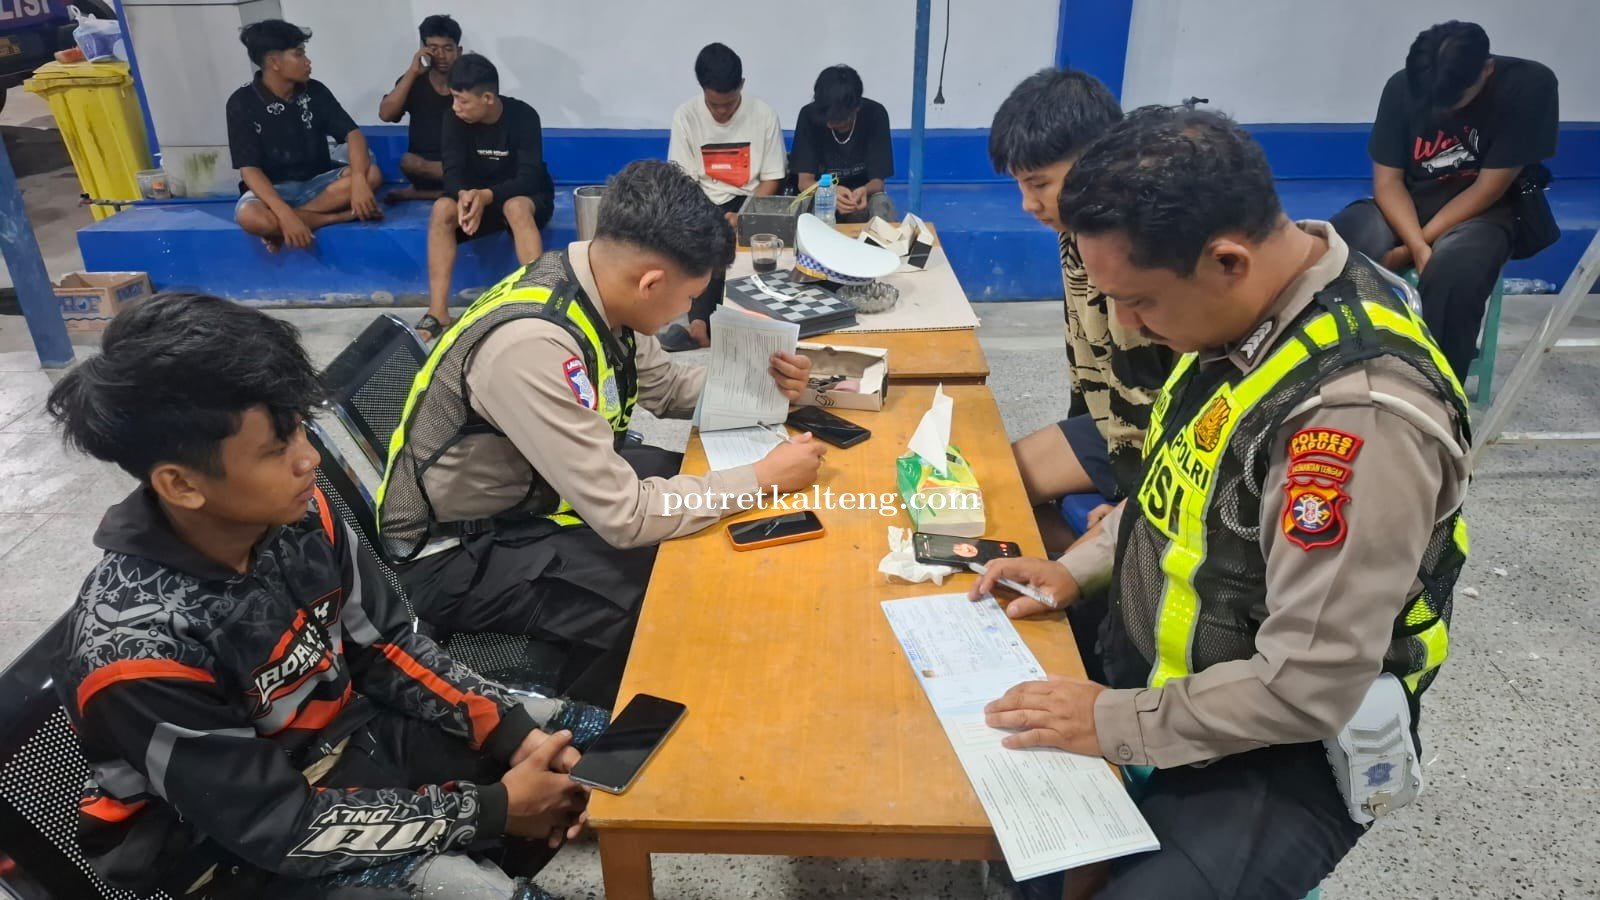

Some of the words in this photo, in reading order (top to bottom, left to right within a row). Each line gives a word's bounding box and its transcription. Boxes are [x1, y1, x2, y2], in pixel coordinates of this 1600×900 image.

[1292, 432, 1353, 449] POLRES
[1293, 442, 1347, 455] KAPUAS
[1172, 433, 1210, 490] POLRI
[320, 809, 390, 824] ONLY
